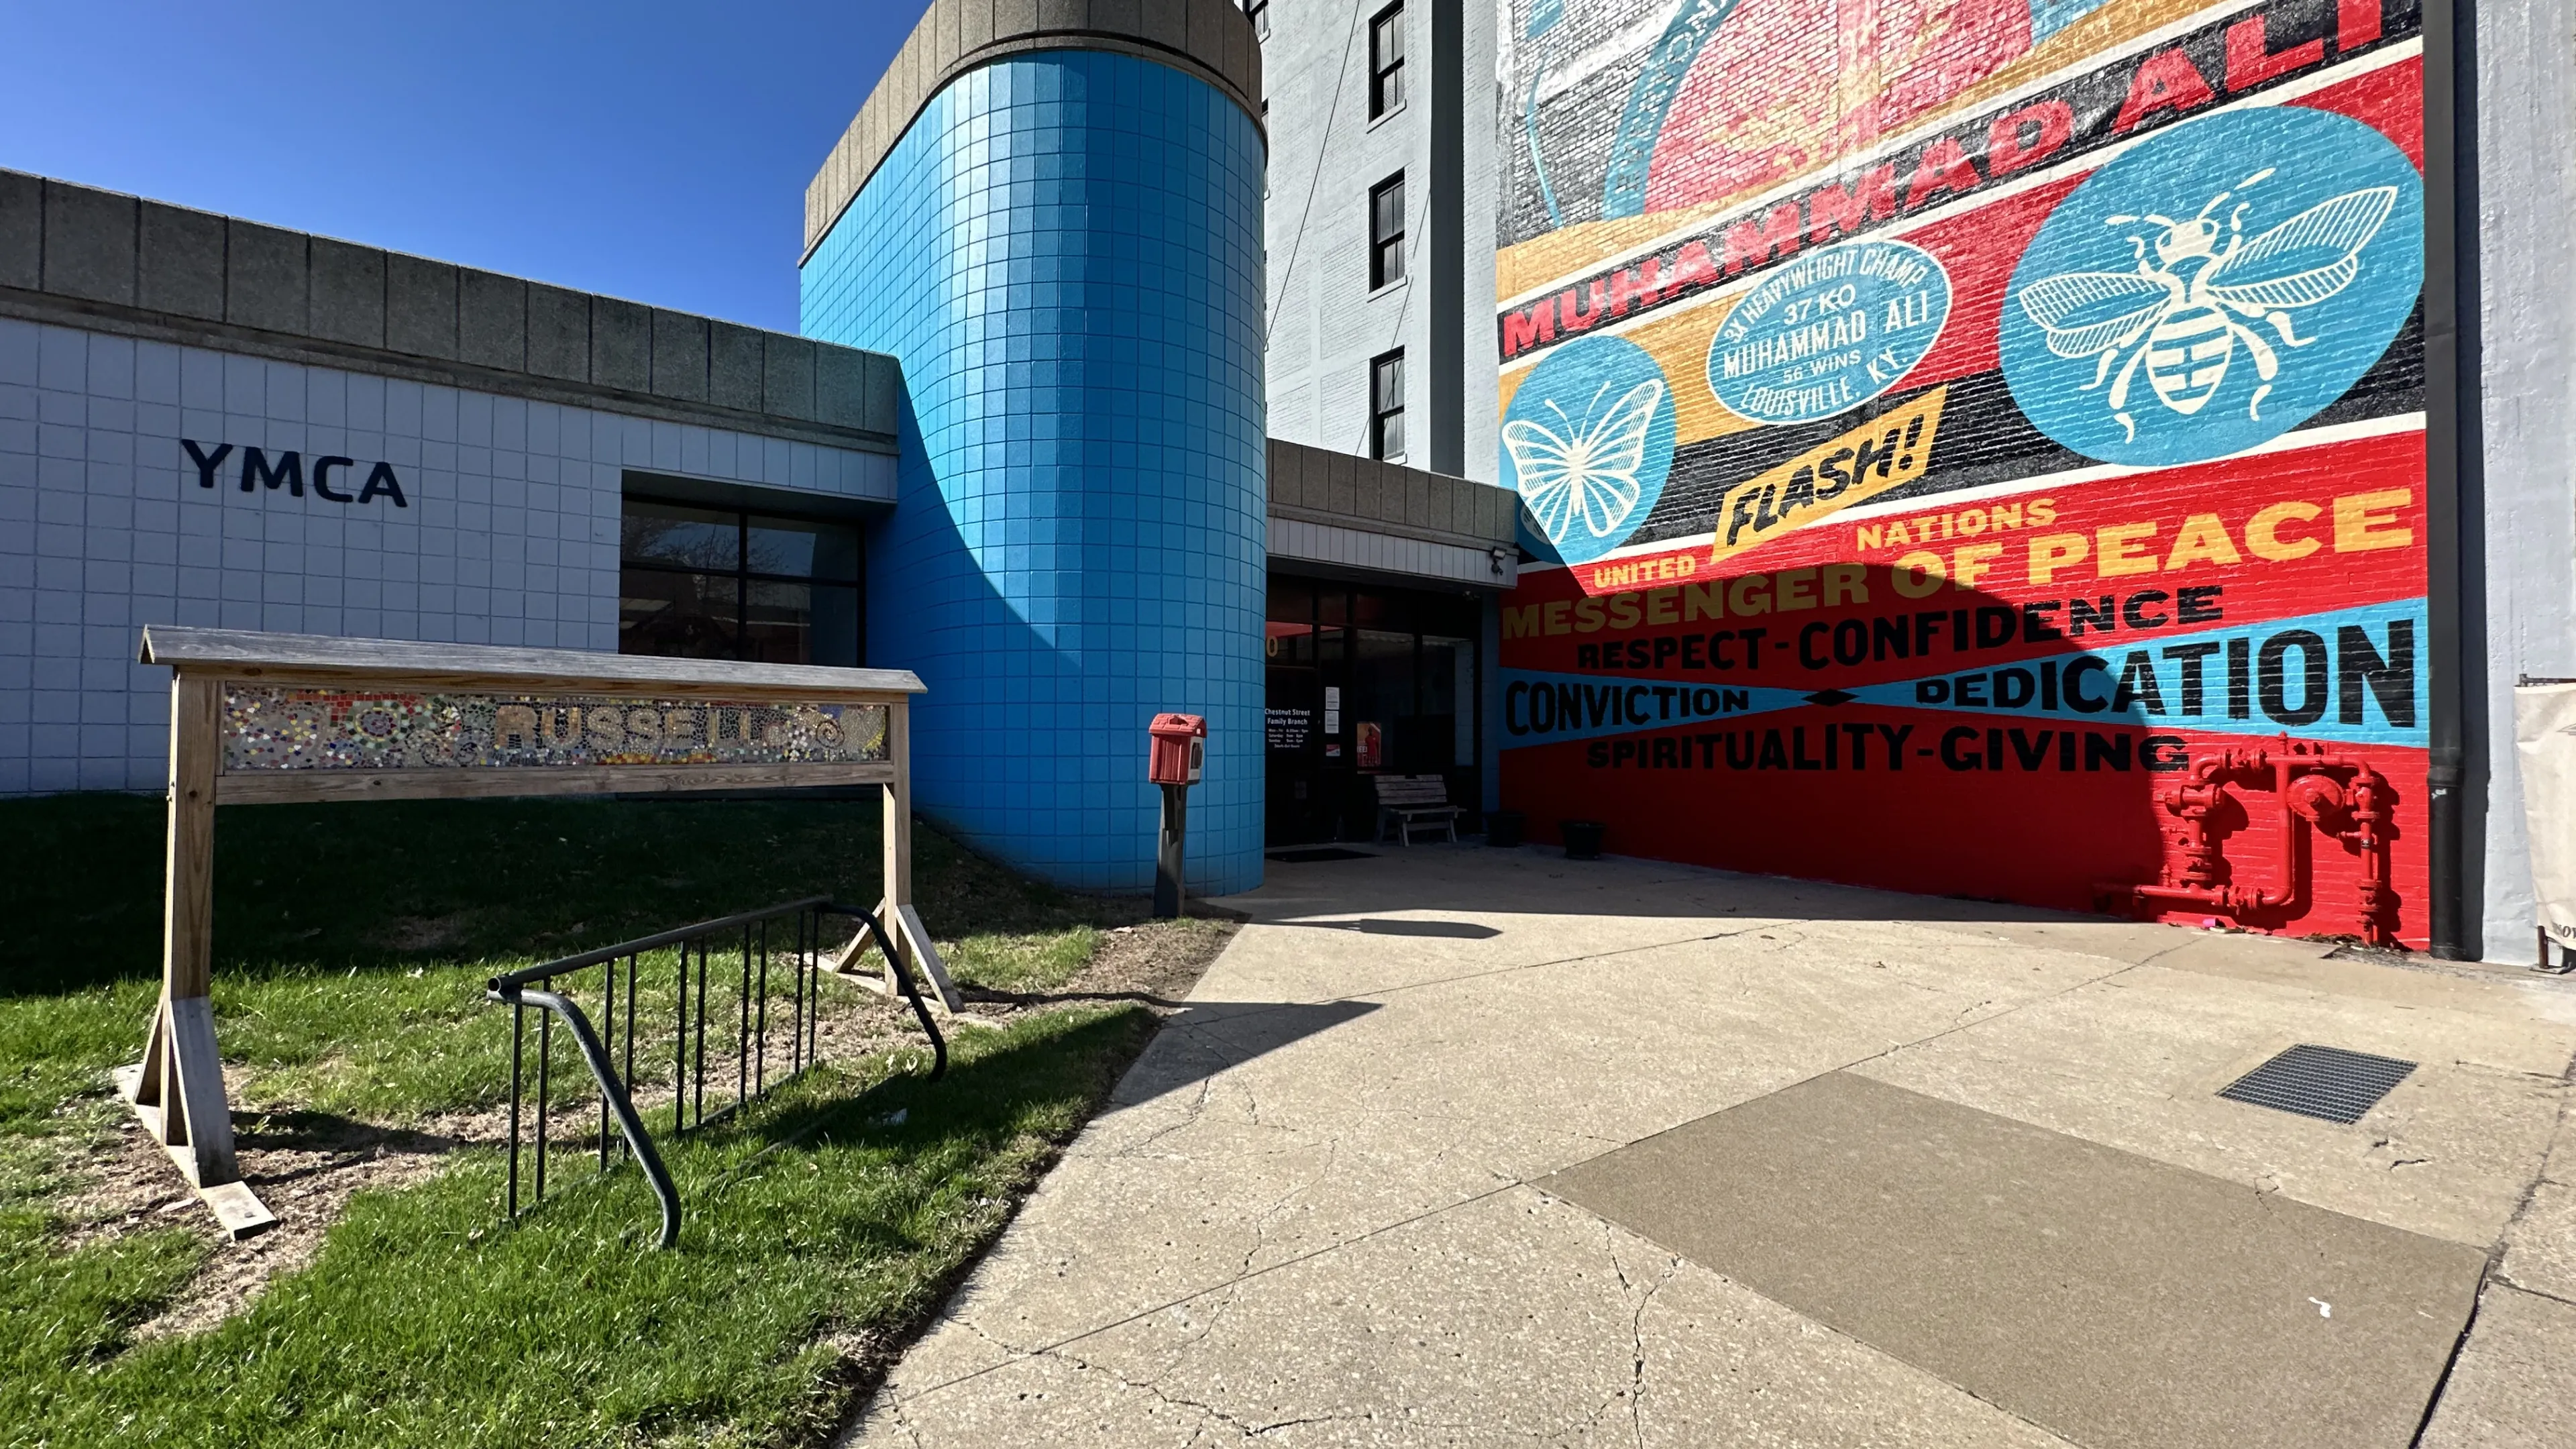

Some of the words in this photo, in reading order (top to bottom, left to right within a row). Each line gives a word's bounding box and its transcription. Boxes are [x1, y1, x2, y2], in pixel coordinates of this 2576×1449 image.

[1503, 101, 2074, 358] MUHAMMAD
[2111, 0, 2382, 134] ALI
[1741, 249, 1858, 325] HEAVYWEIGHT
[1859, 248, 1929, 288] CHAMP
[1784, 301, 1811, 325] 37
[1819, 283, 1856, 315] KO
[1723, 309, 1866, 380] MUHAMMAD
[1885, 290, 1927, 333] ALI
[1784, 368, 1803, 384] 56
[1812, 351, 1862, 376] WINS
[1866, 347, 1908, 385] KY.
[180, 439, 408, 508] YMCA
[1726, 414, 1925, 547] FLASH!
[1503, 564, 1869, 639] MESSENGER
[1891, 542, 2003, 599] OF
[2029, 488, 2413, 585] PEACE
[1595, 554, 1696, 588] UNITED
[1856, 498, 2057, 552] NATIONS
[1292, 708, 1311, 716] Street
[1505, 680, 1749, 736] CONVICTION
[1916, 619, 2414, 728] DEDICATION
[1267, 717, 1286, 726] Family
